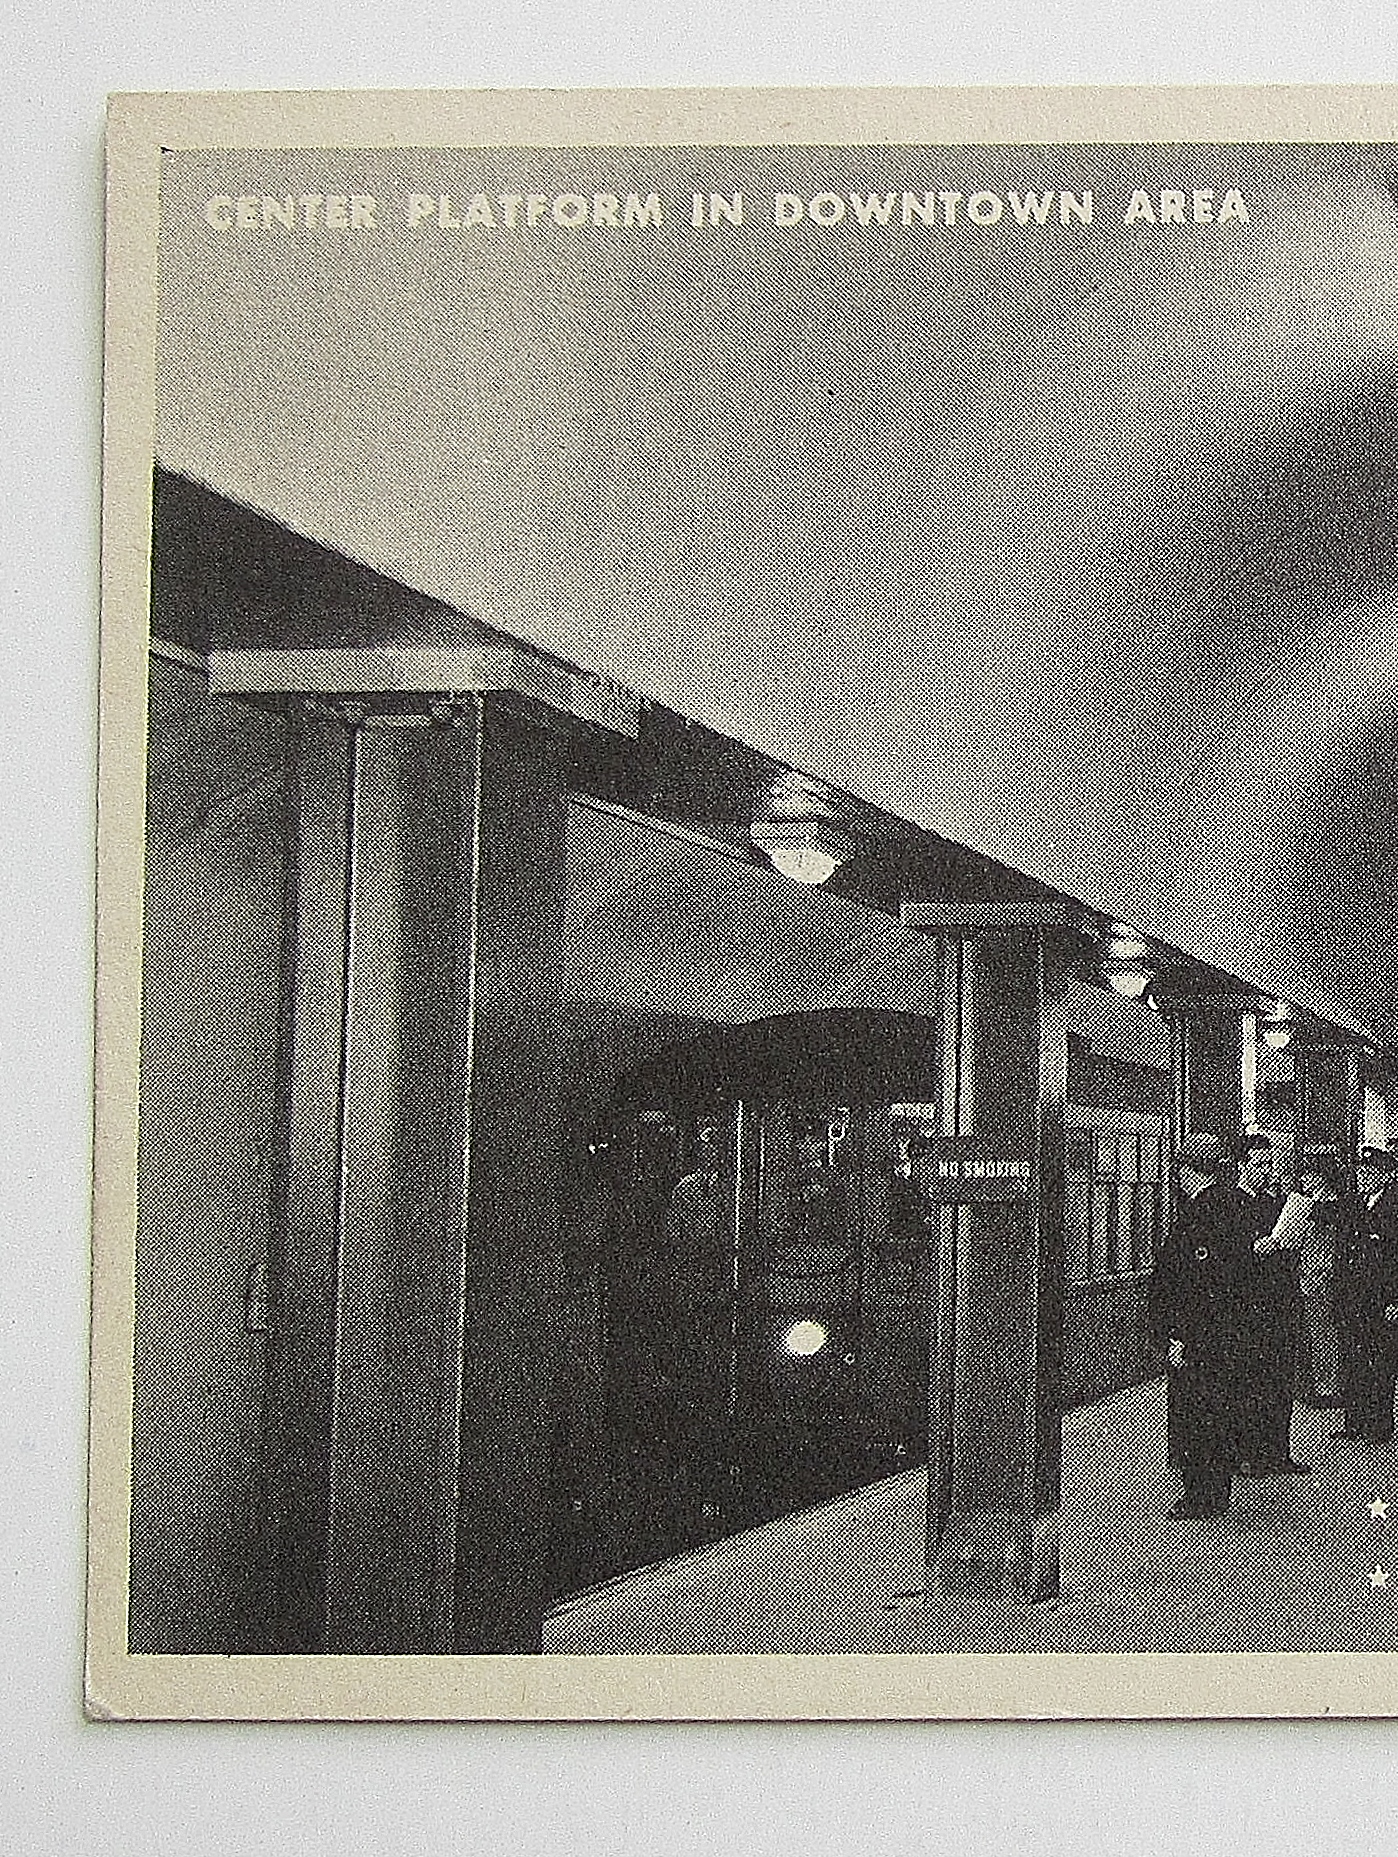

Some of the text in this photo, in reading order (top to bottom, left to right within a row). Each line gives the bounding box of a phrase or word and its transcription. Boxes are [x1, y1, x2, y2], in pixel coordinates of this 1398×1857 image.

[206, 188, 1252, 231] CENTER PLATFORM IN DOWNTOWN AREA
[938, 1160, 1031, 1179] NO SMOKING
